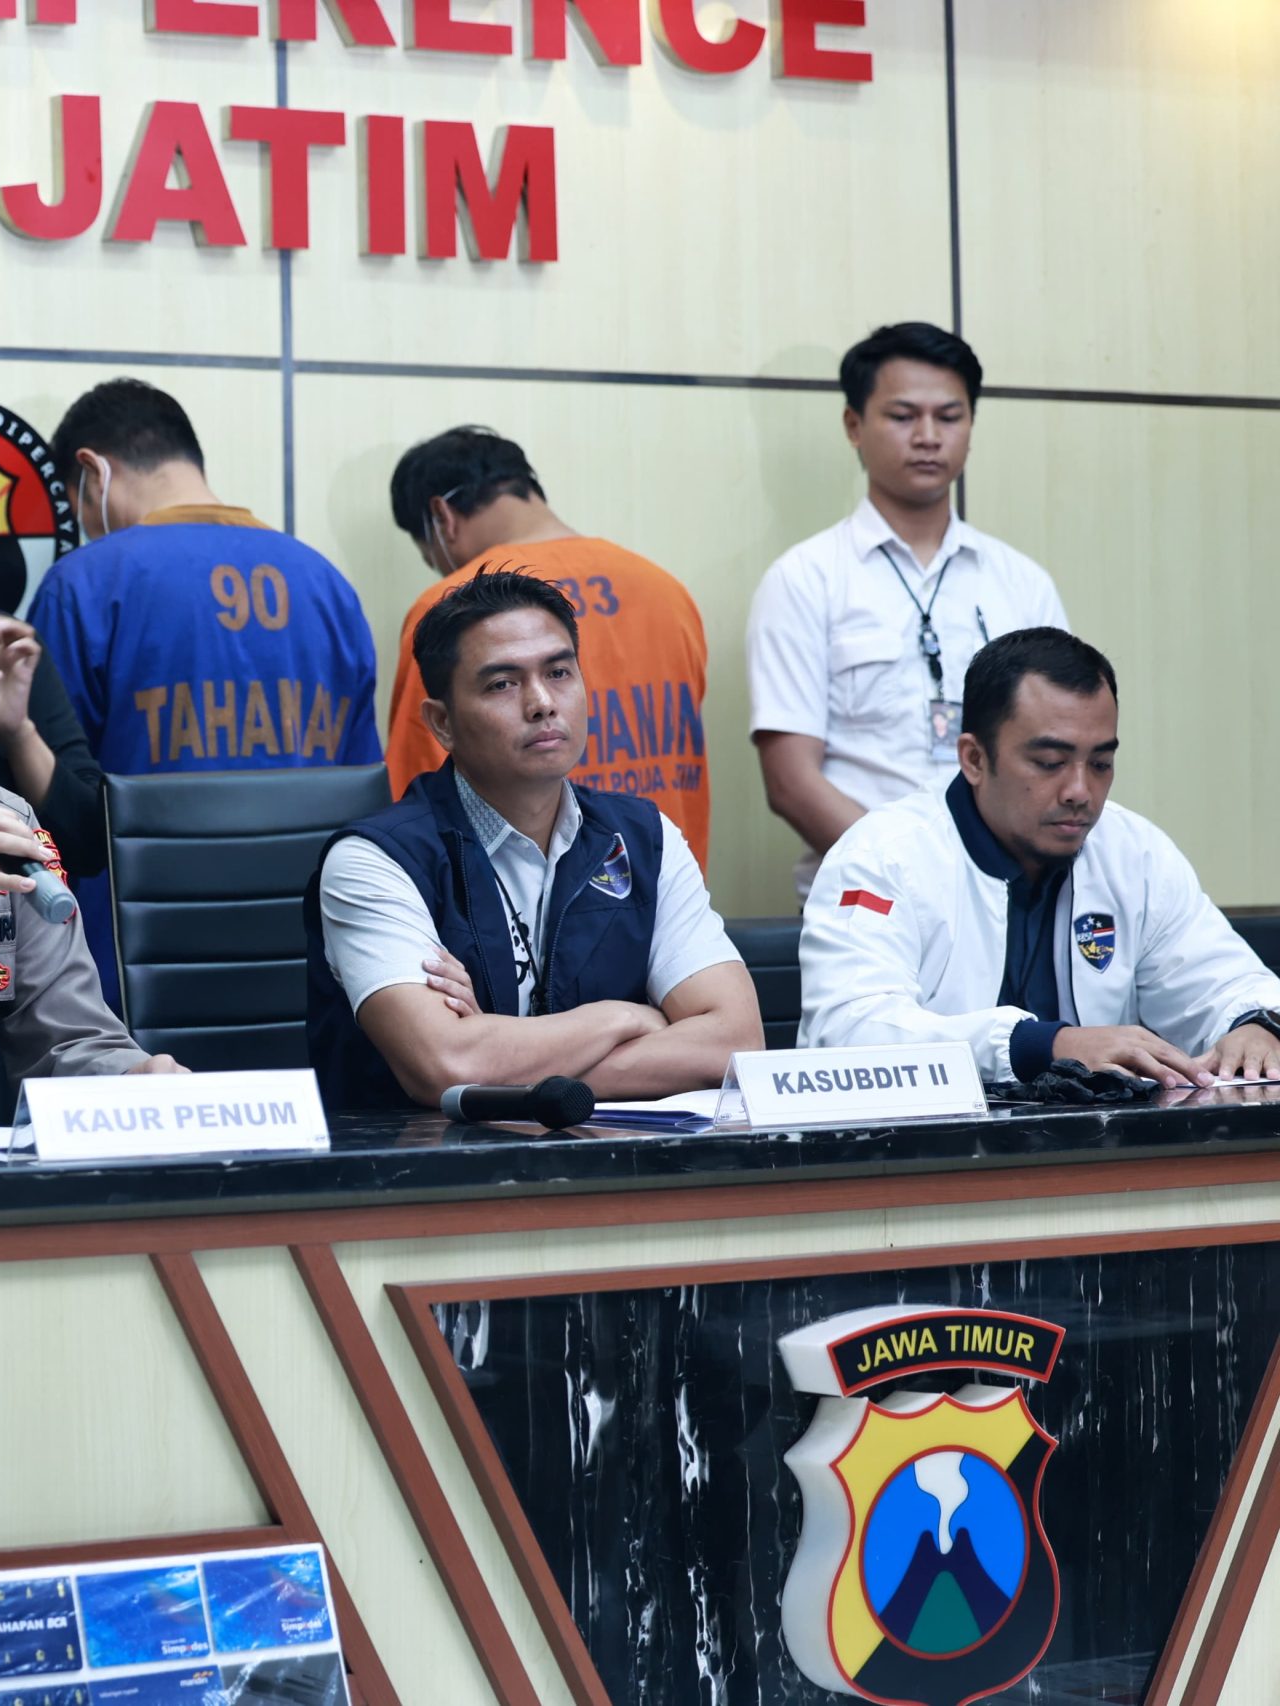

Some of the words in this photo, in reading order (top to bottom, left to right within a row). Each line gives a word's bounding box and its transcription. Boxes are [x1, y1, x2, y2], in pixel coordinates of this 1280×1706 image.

[210, 563, 290, 632] 90
[772, 1065, 919, 1095] KASUBDIT
[928, 1063, 949, 1086] II
[62, 1107, 165, 1134] KAUR
[174, 1102, 298, 1129] PENUM
[856, 1328, 939, 1373] JAWA
[945, 1325, 1035, 1362] TIMUR
[46, 1616, 68, 1629] BCA
